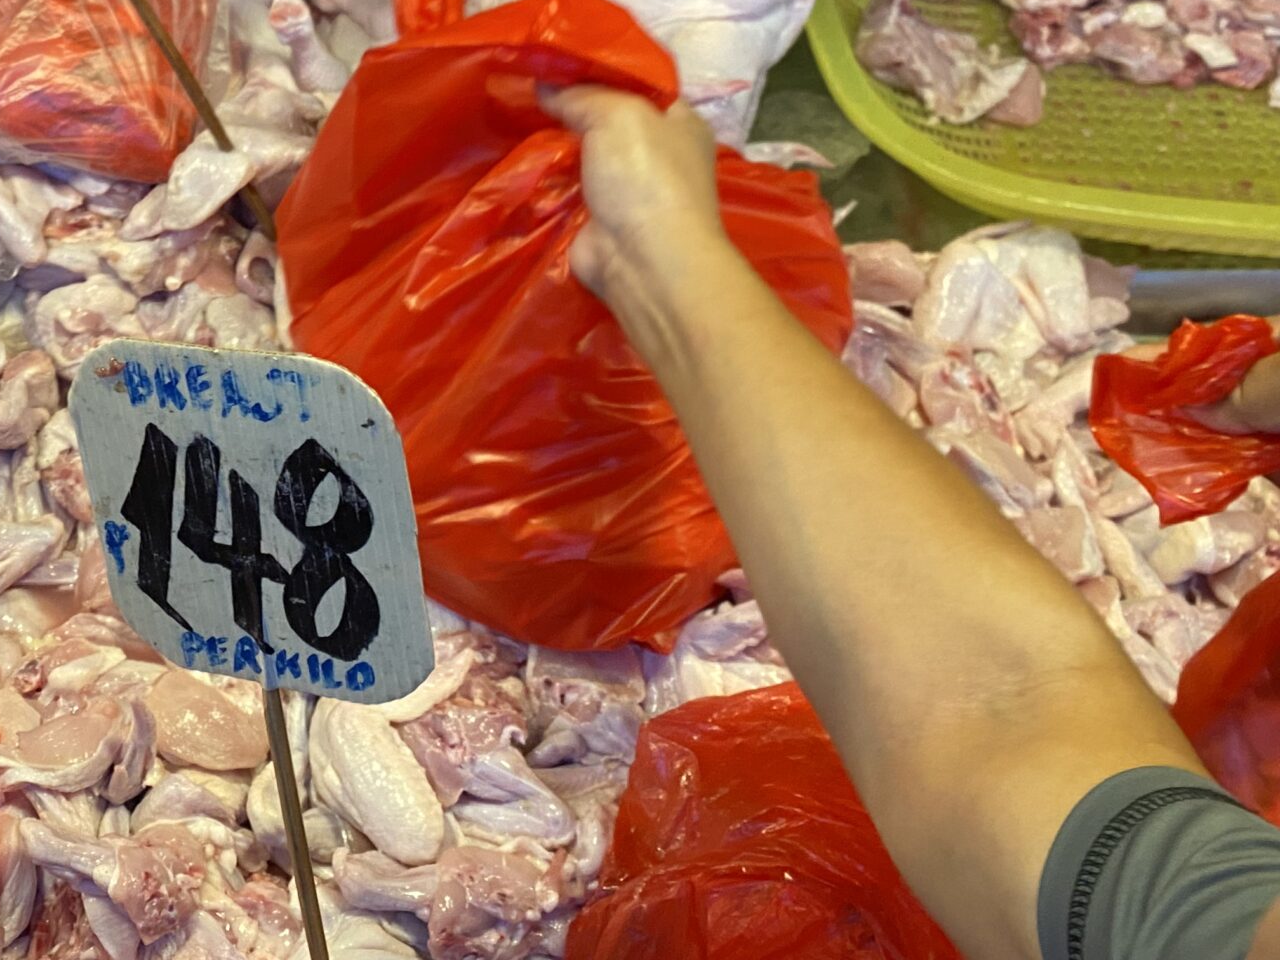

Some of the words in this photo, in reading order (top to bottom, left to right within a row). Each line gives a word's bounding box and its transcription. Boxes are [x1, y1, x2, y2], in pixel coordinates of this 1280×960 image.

[120, 422, 380, 662] 148
[181, 631, 261, 673] PER
[276, 649, 375, 691] KILO
